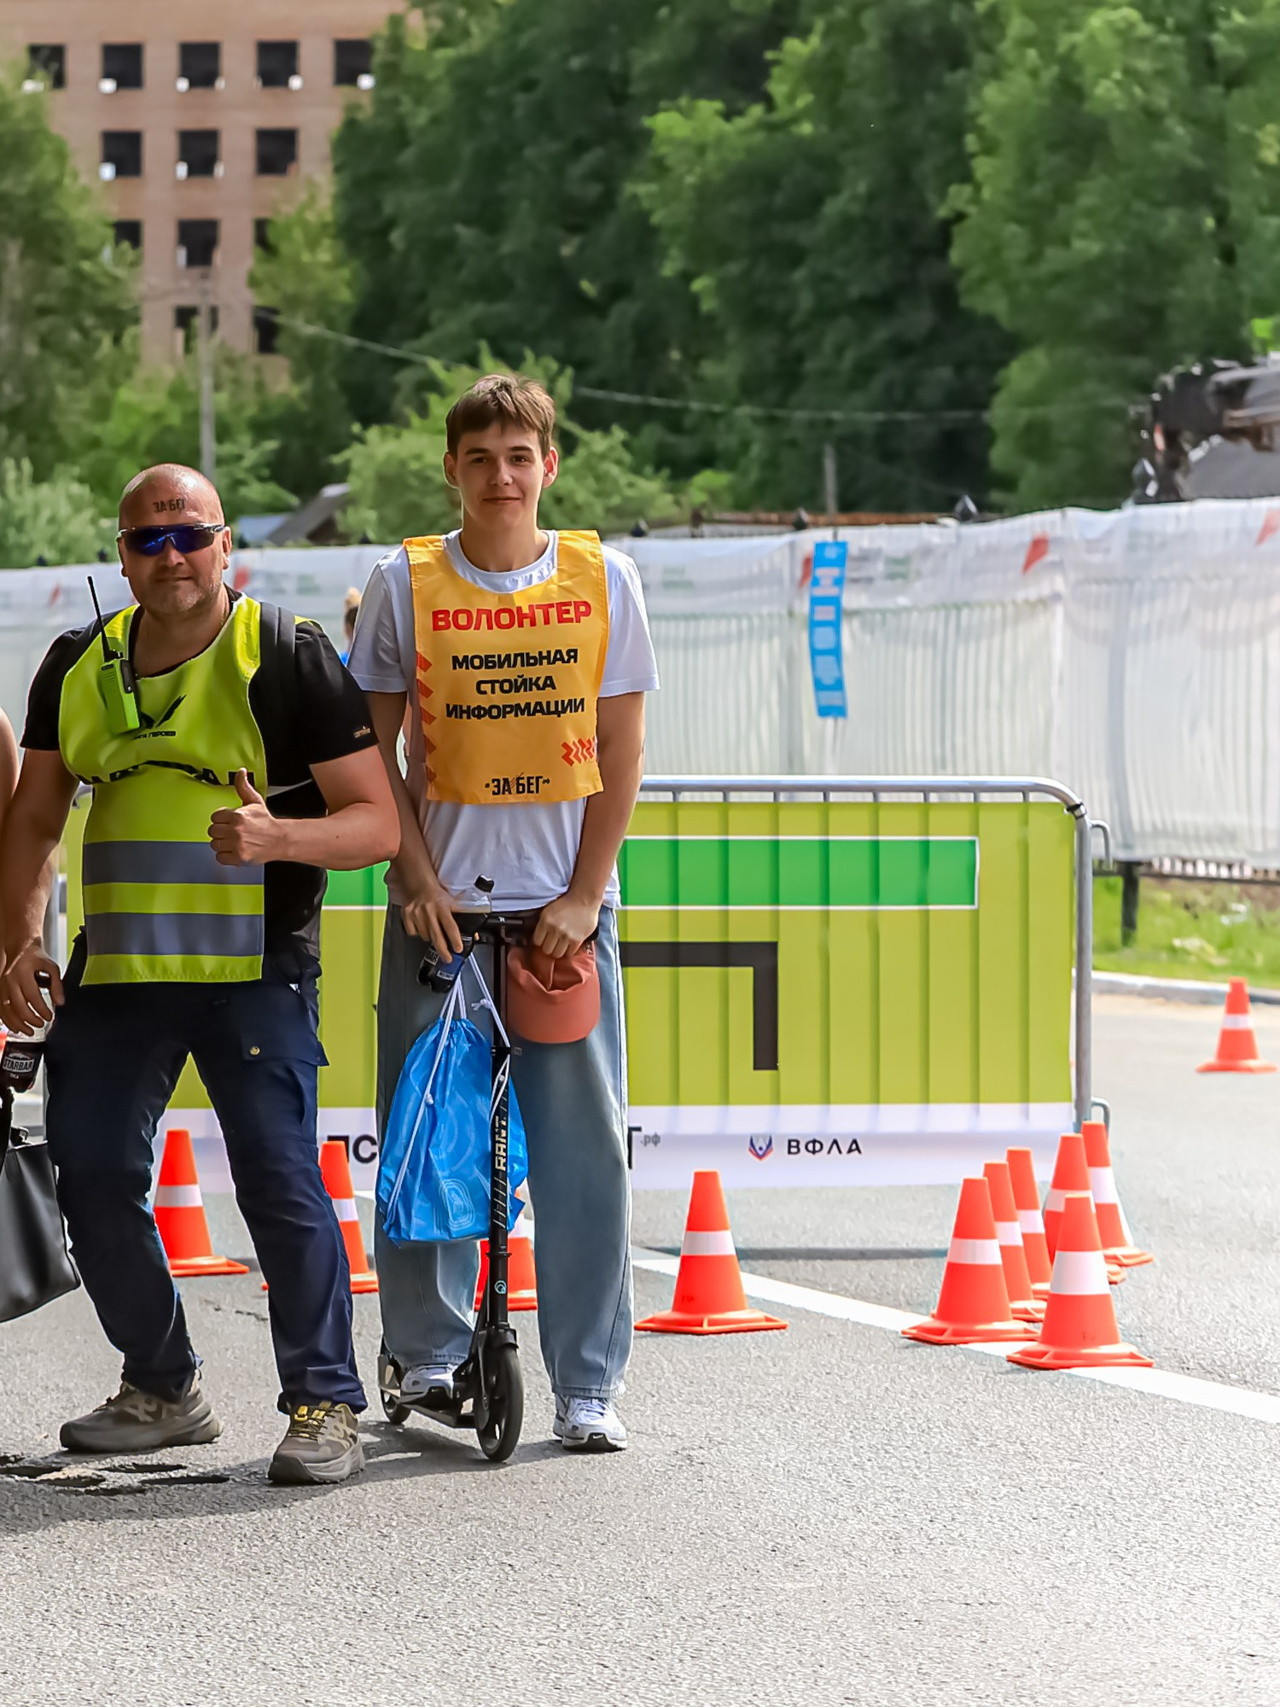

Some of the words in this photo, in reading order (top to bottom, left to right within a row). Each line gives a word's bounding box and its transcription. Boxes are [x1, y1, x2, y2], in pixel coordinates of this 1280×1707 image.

[432, 600, 592, 632] ВОЛОНТЕР
[451, 648, 579, 670] МОБИЛЬНАЯ
[475, 674, 557, 695] СТОЙКА
[445, 698, 586, 720] ИНФОРМАЦИИ
[787, 1138, 862, 1156] ВФЛА
